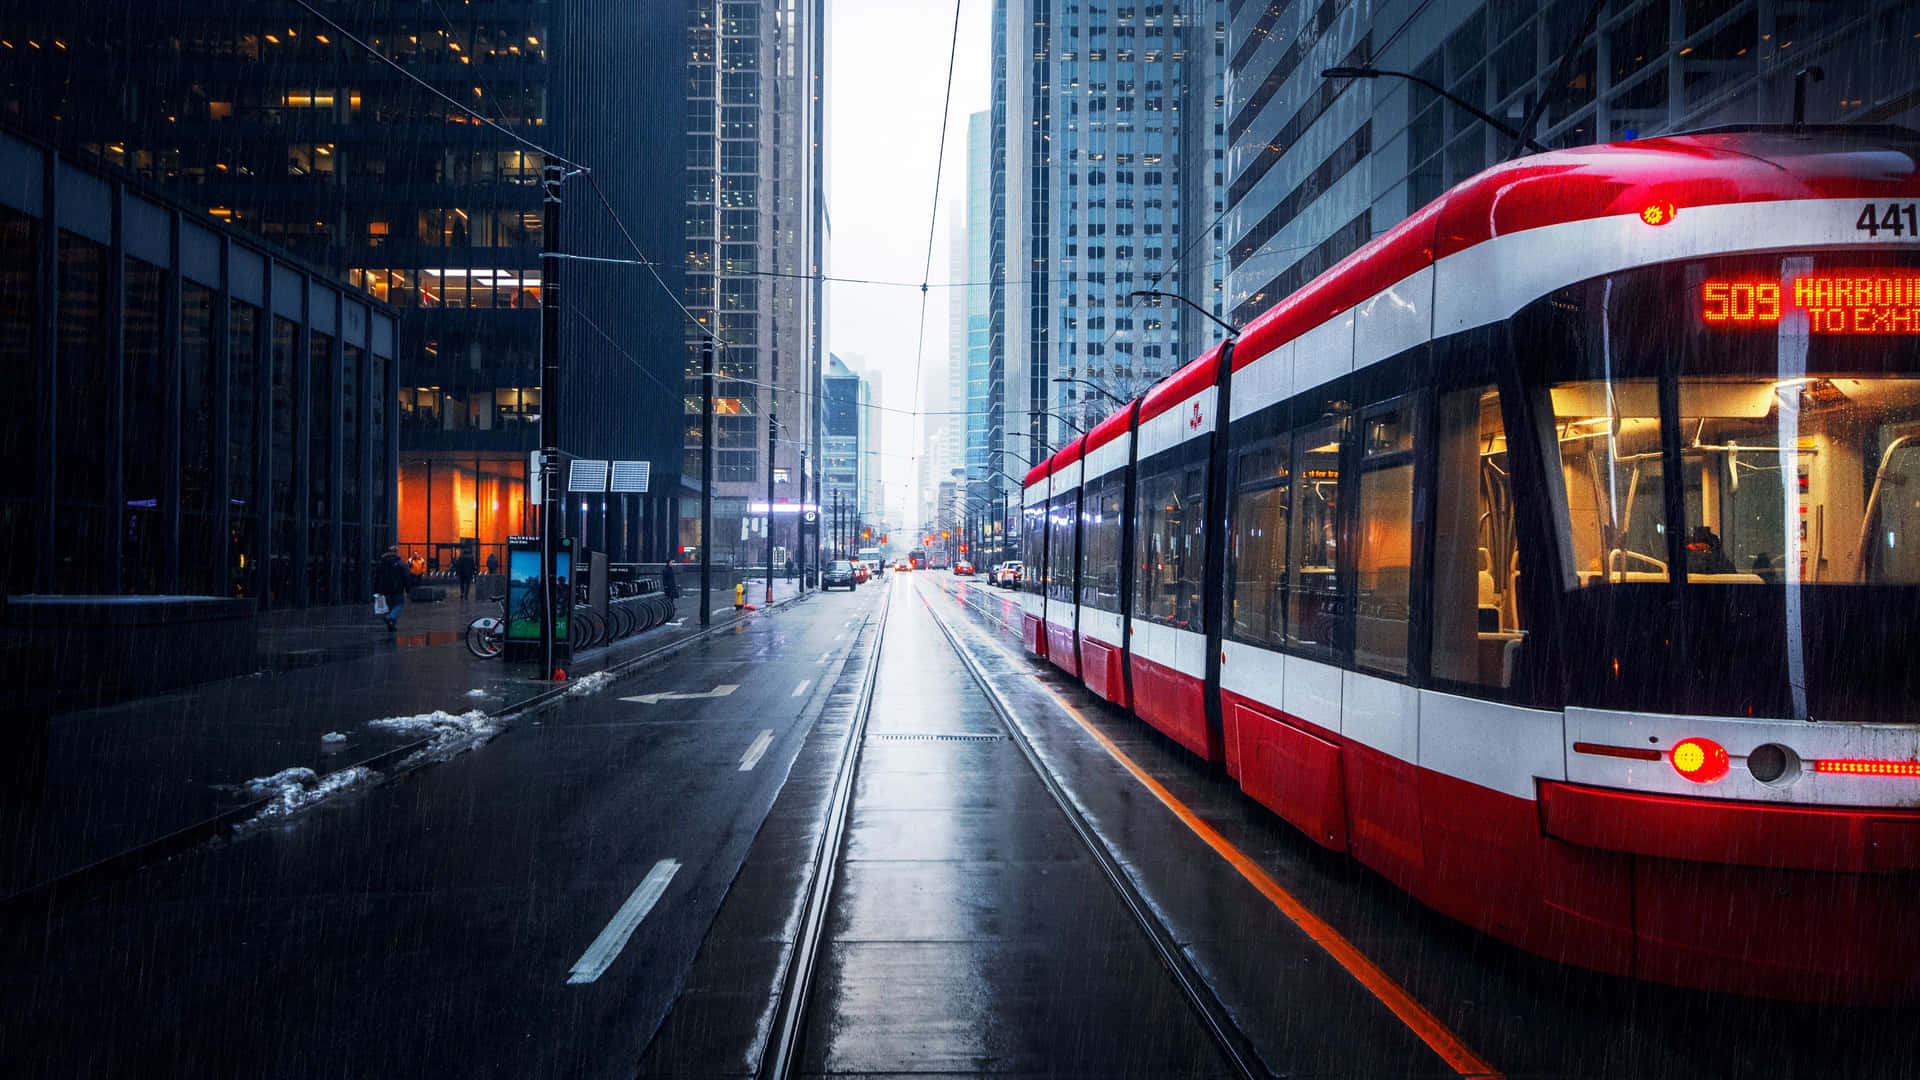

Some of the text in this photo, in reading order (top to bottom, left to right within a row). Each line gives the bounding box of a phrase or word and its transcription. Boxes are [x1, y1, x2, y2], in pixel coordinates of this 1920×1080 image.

[1856, 203, 1918, 236] 441
[1703, 283, 1780, 320] 509
[1809, 308, 1844, 331] TO
